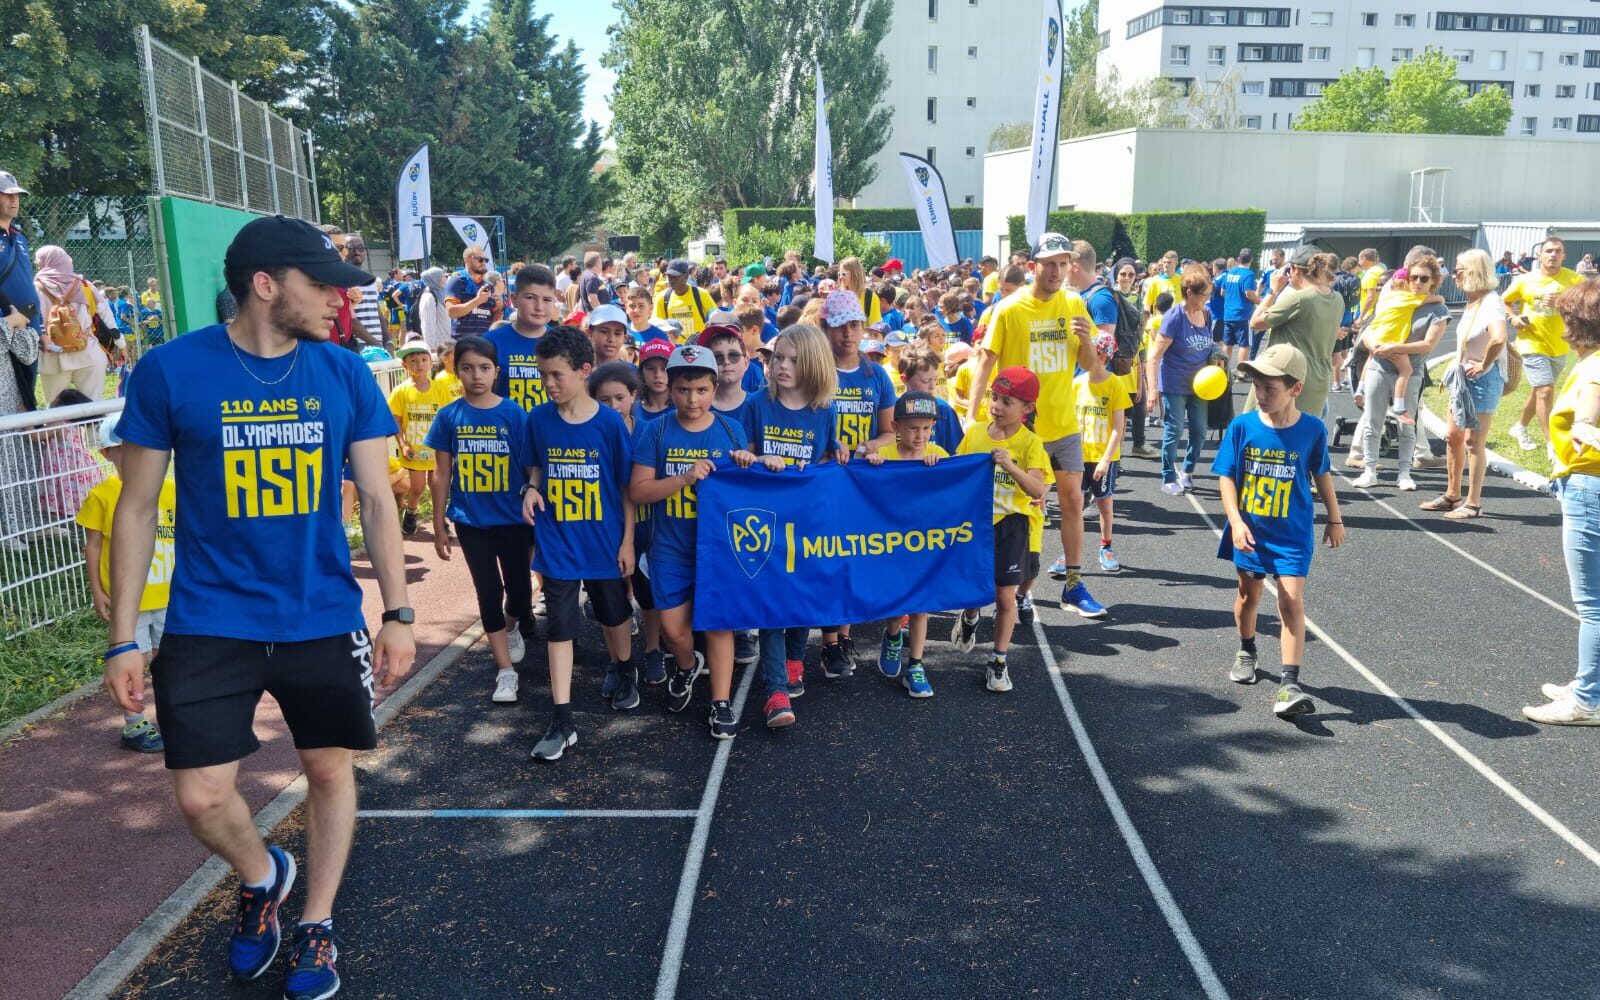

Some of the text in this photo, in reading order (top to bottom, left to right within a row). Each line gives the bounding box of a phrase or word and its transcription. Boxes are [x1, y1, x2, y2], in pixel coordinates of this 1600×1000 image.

[411, 192, 419, 217] RUGBY
[926, 196, 938, 226] TENNIS
[1029, 342, 1068, 373] ASM
[843, 387, 862, 395] ANS
[221, 398, 298, 414] 110 ANS
[222, 421, 324, 447] OLYMPIADES
[456, 425, 473, 434] 110
[476, 425, 497, 434] ANS
[764, 425, 780, 435] 110
[783, 428, 804, 438] ANS
[458, 440, 510, 453] OLYMPIADES
[547, 448, 563, 457] 110
[564, 448, 586, 458] ANS
[667, 447, 685, 457] 110
[686, 448, 709, 458] ANS
[763, 440, 813, 459] OLYMPIADES
[1245, 447, 1286, 459] 110 ANS
[458, 454, 510, 492] ASM
[548, 463, 600, 479] OLYMPIADES
[1245, 459, 1296, 479] OLYMPIADES
[223, 446, 323, 518] ASM
[547, 479, 603, 521] ASM
[1239, 472, 1293, 518] ASM
[803, 521, 974, 559] MULTISPORTS
